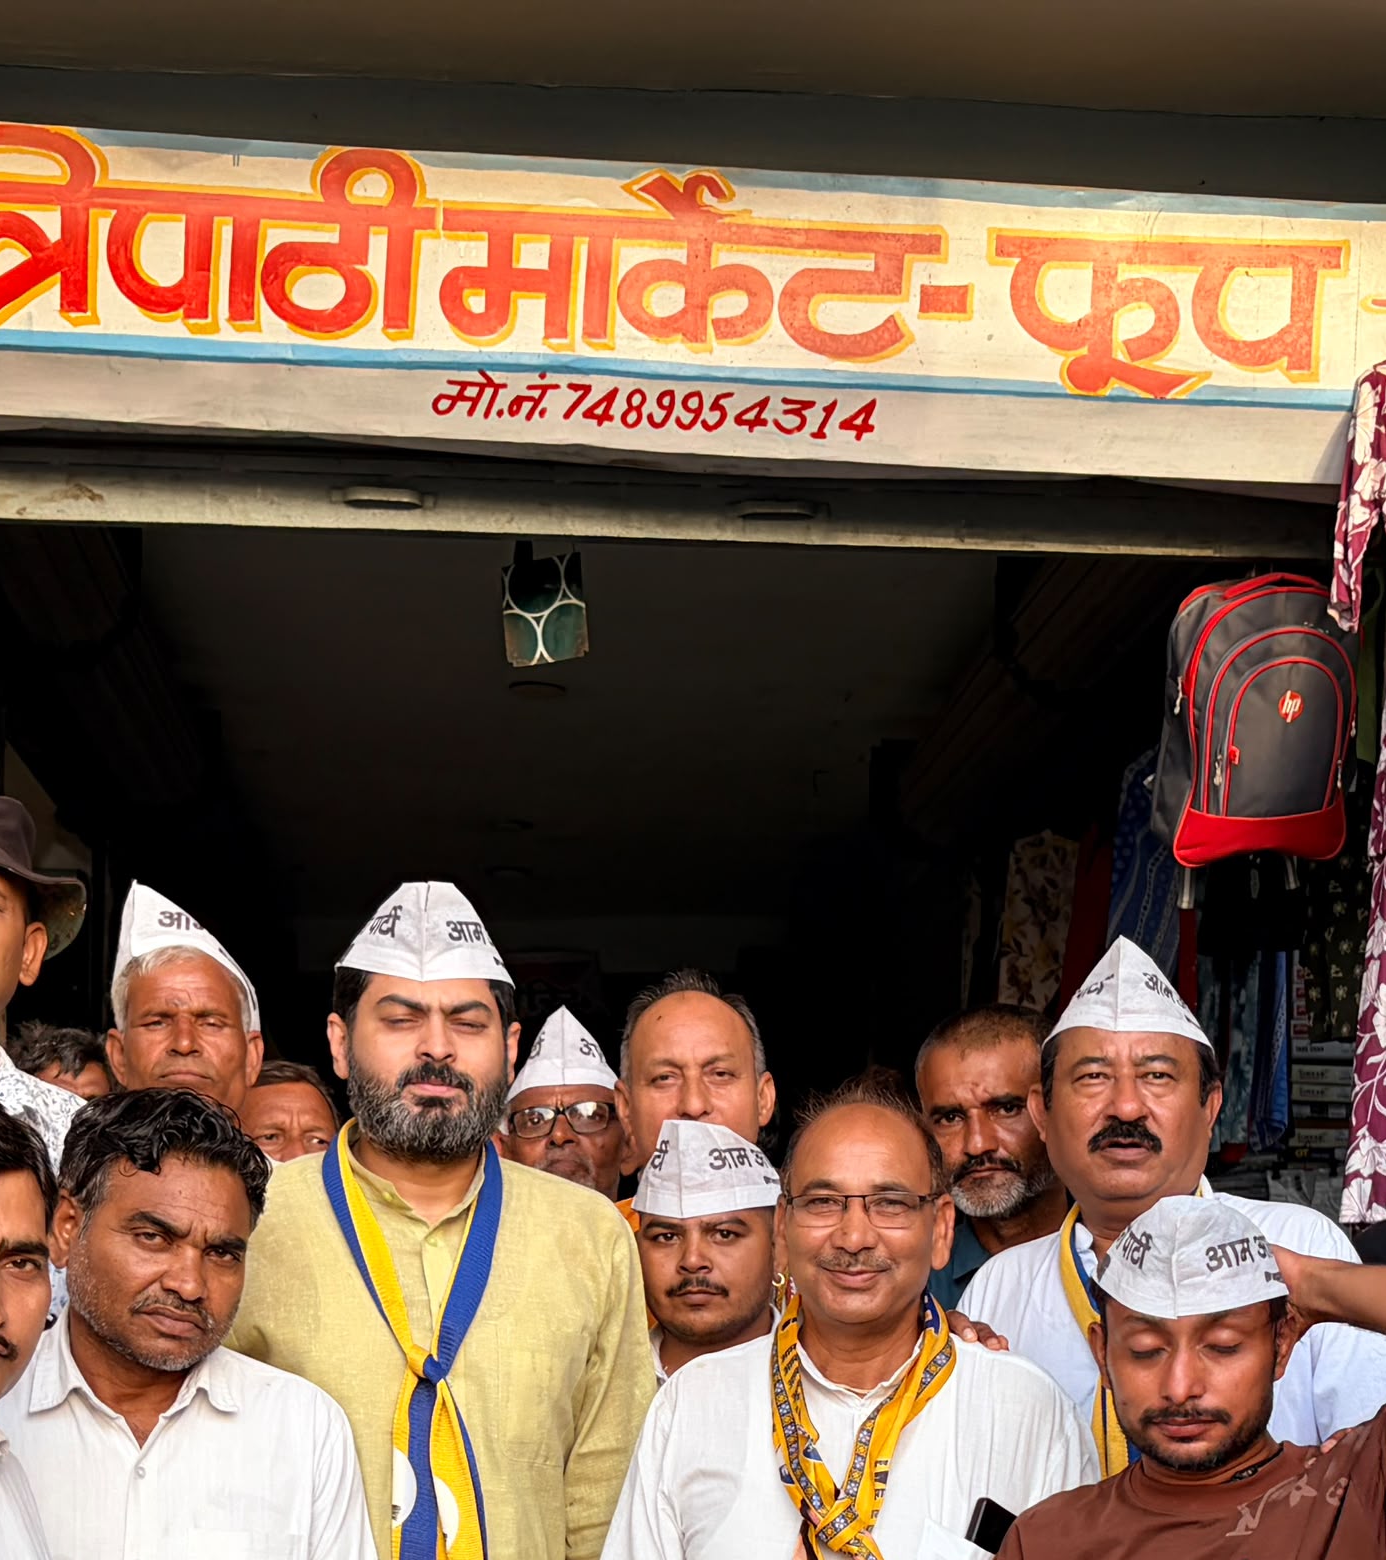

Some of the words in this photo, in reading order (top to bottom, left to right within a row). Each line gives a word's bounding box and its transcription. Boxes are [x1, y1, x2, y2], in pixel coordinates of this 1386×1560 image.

[1282, 690, 1301, 722] hp
[708, 1148, 752, 1170] आम
[1205, 1237, 1255, 1273] आम
